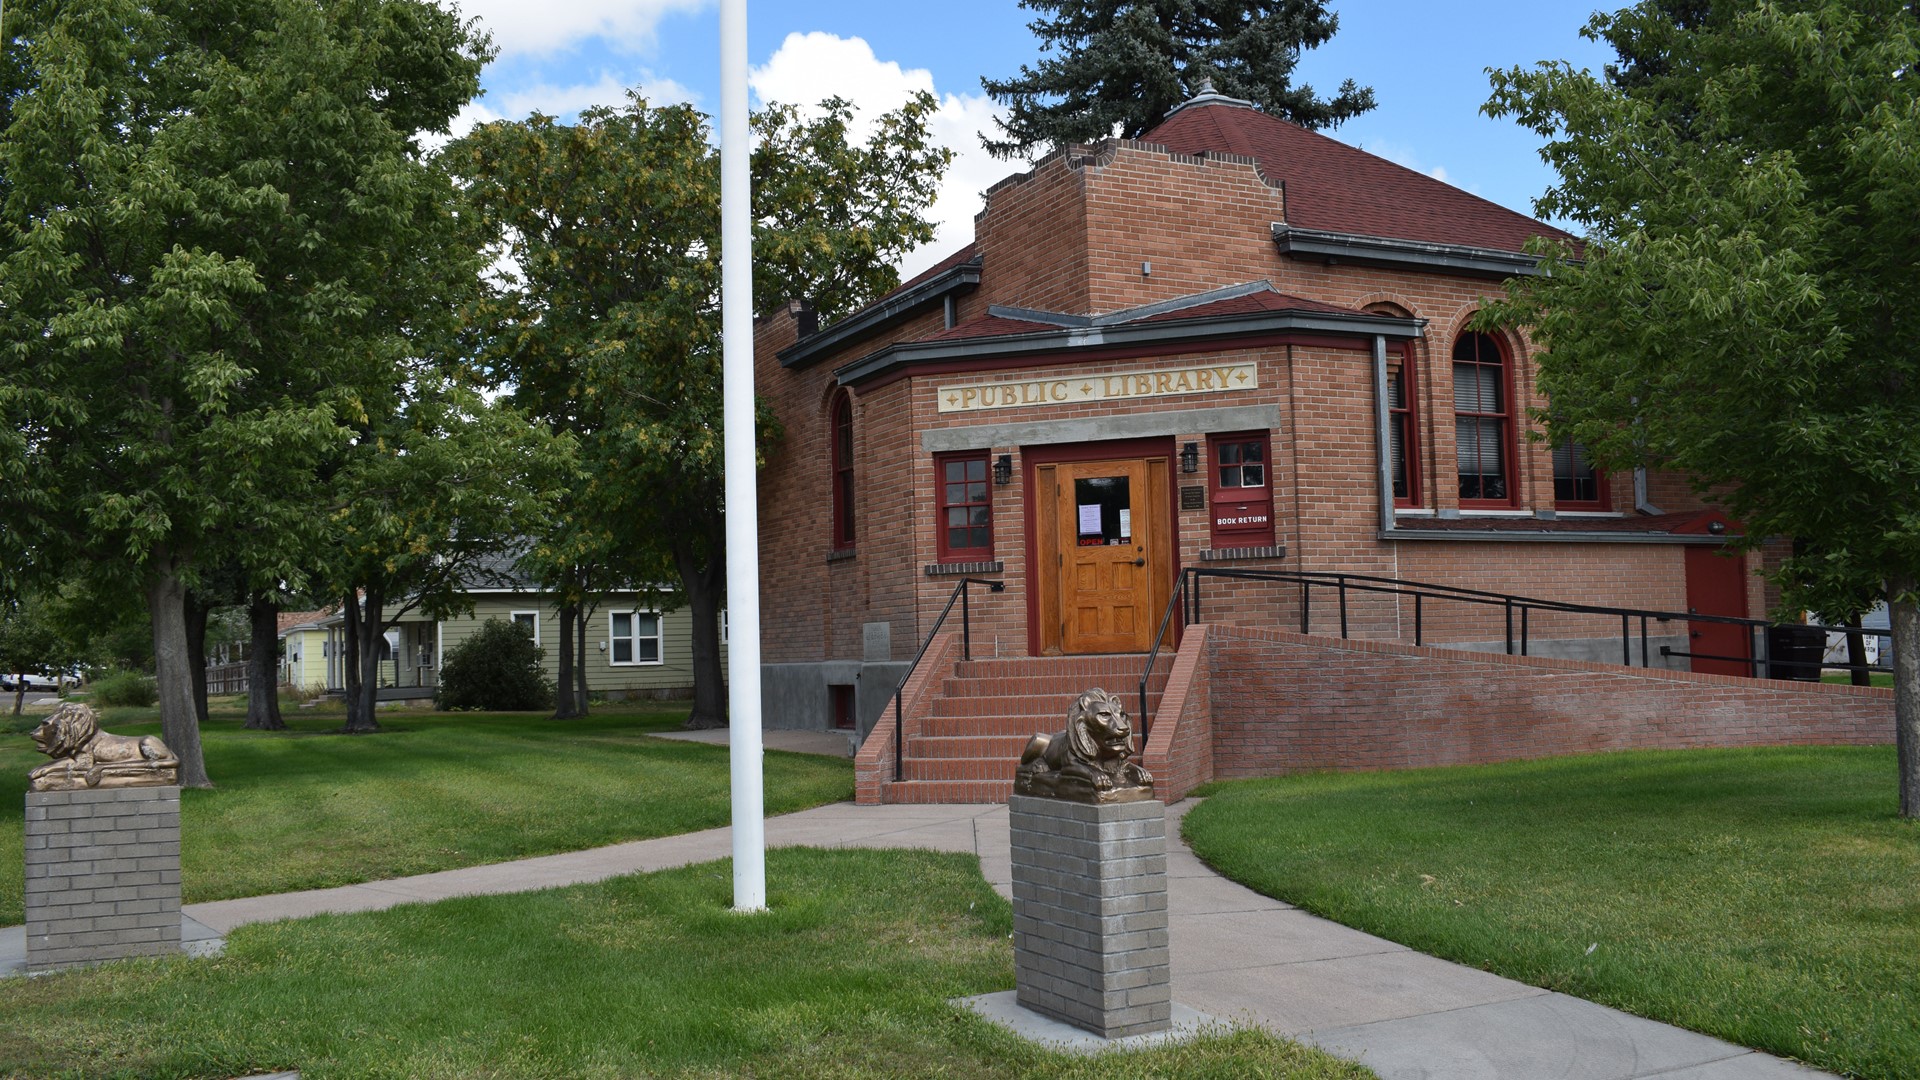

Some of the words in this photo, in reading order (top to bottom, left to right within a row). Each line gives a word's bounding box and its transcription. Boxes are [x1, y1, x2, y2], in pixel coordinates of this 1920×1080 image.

[960, 381, 1068, 409] PUBLIC
[1102, 367, 1235, 398] LIBRARY
[1238, 516, 1267, 524] RETURN
[1080, 538, 1103, 546] OPEN
